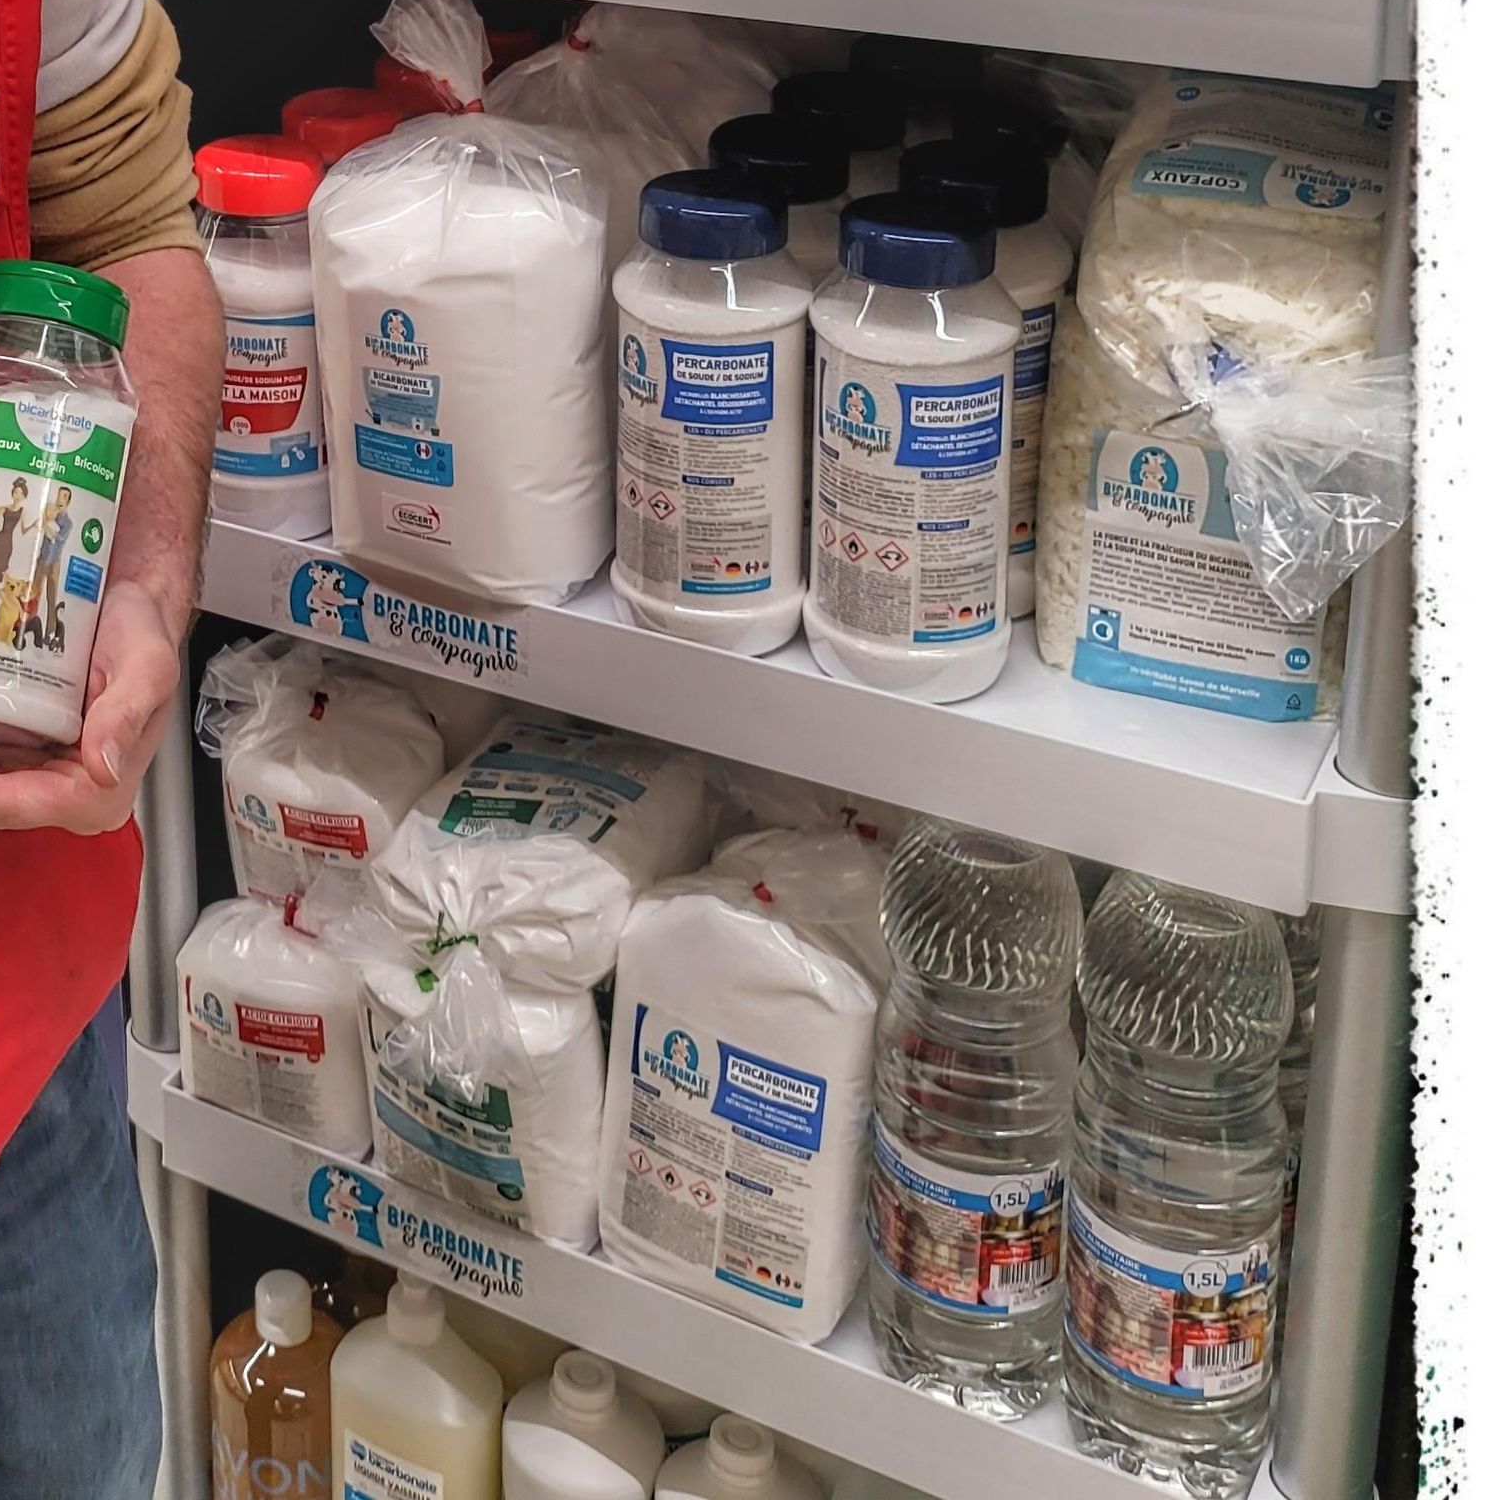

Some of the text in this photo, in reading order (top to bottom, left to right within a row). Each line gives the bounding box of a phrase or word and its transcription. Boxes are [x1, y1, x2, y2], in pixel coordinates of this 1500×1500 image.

[1152, 170, 1240, 190] COPEAUX
[677, 355, 766, 370] PERCARBONATE
[283, 374, 302, 383] POUR
[373, 371, 428, 388] BICARBONATE
[677, 370, 764, 382] DE SOUDE DE SODIUM
[232, 386, 297, 401] LA MAISON
[915, 393, 999, 412] PERCARBONATE
[18, 400, 93, 431] bicarbonate
[915, 414, 924, 423] DE
[926, 414, 955, 423] SOUDE
[29, 455, 66, 475] Jardin
[74, 455, 116, 481] Bricolage
[1103, 482, 1195, 513] BICARBONATE
[398, 511, 433, 525] ECOCERT
[1125, 500, 1195, 528] compagnie
[1169, 555, 1195, 568] SAVON
[1197, 561, 1206, 570] DE
[1209, 564, 1250, 579] MARSEILLE
[374, 592, 517, 654] BICARBONATE
[411, 627, 517, 677] compagnie
[1220, 684, 1261, 699] Marseille
[731, 1060, 817, 1100] PERCARBONATE
[994, 1192, 1027, 1211] 1,5L
[387, 1204, 523, 1282] BICARBONATE
[423, 1241, 523, 1298] compagnie
[1187, 1271, 1223, 1290] 1,5L
[368, 1448, 437, 1494] bicarbonate
